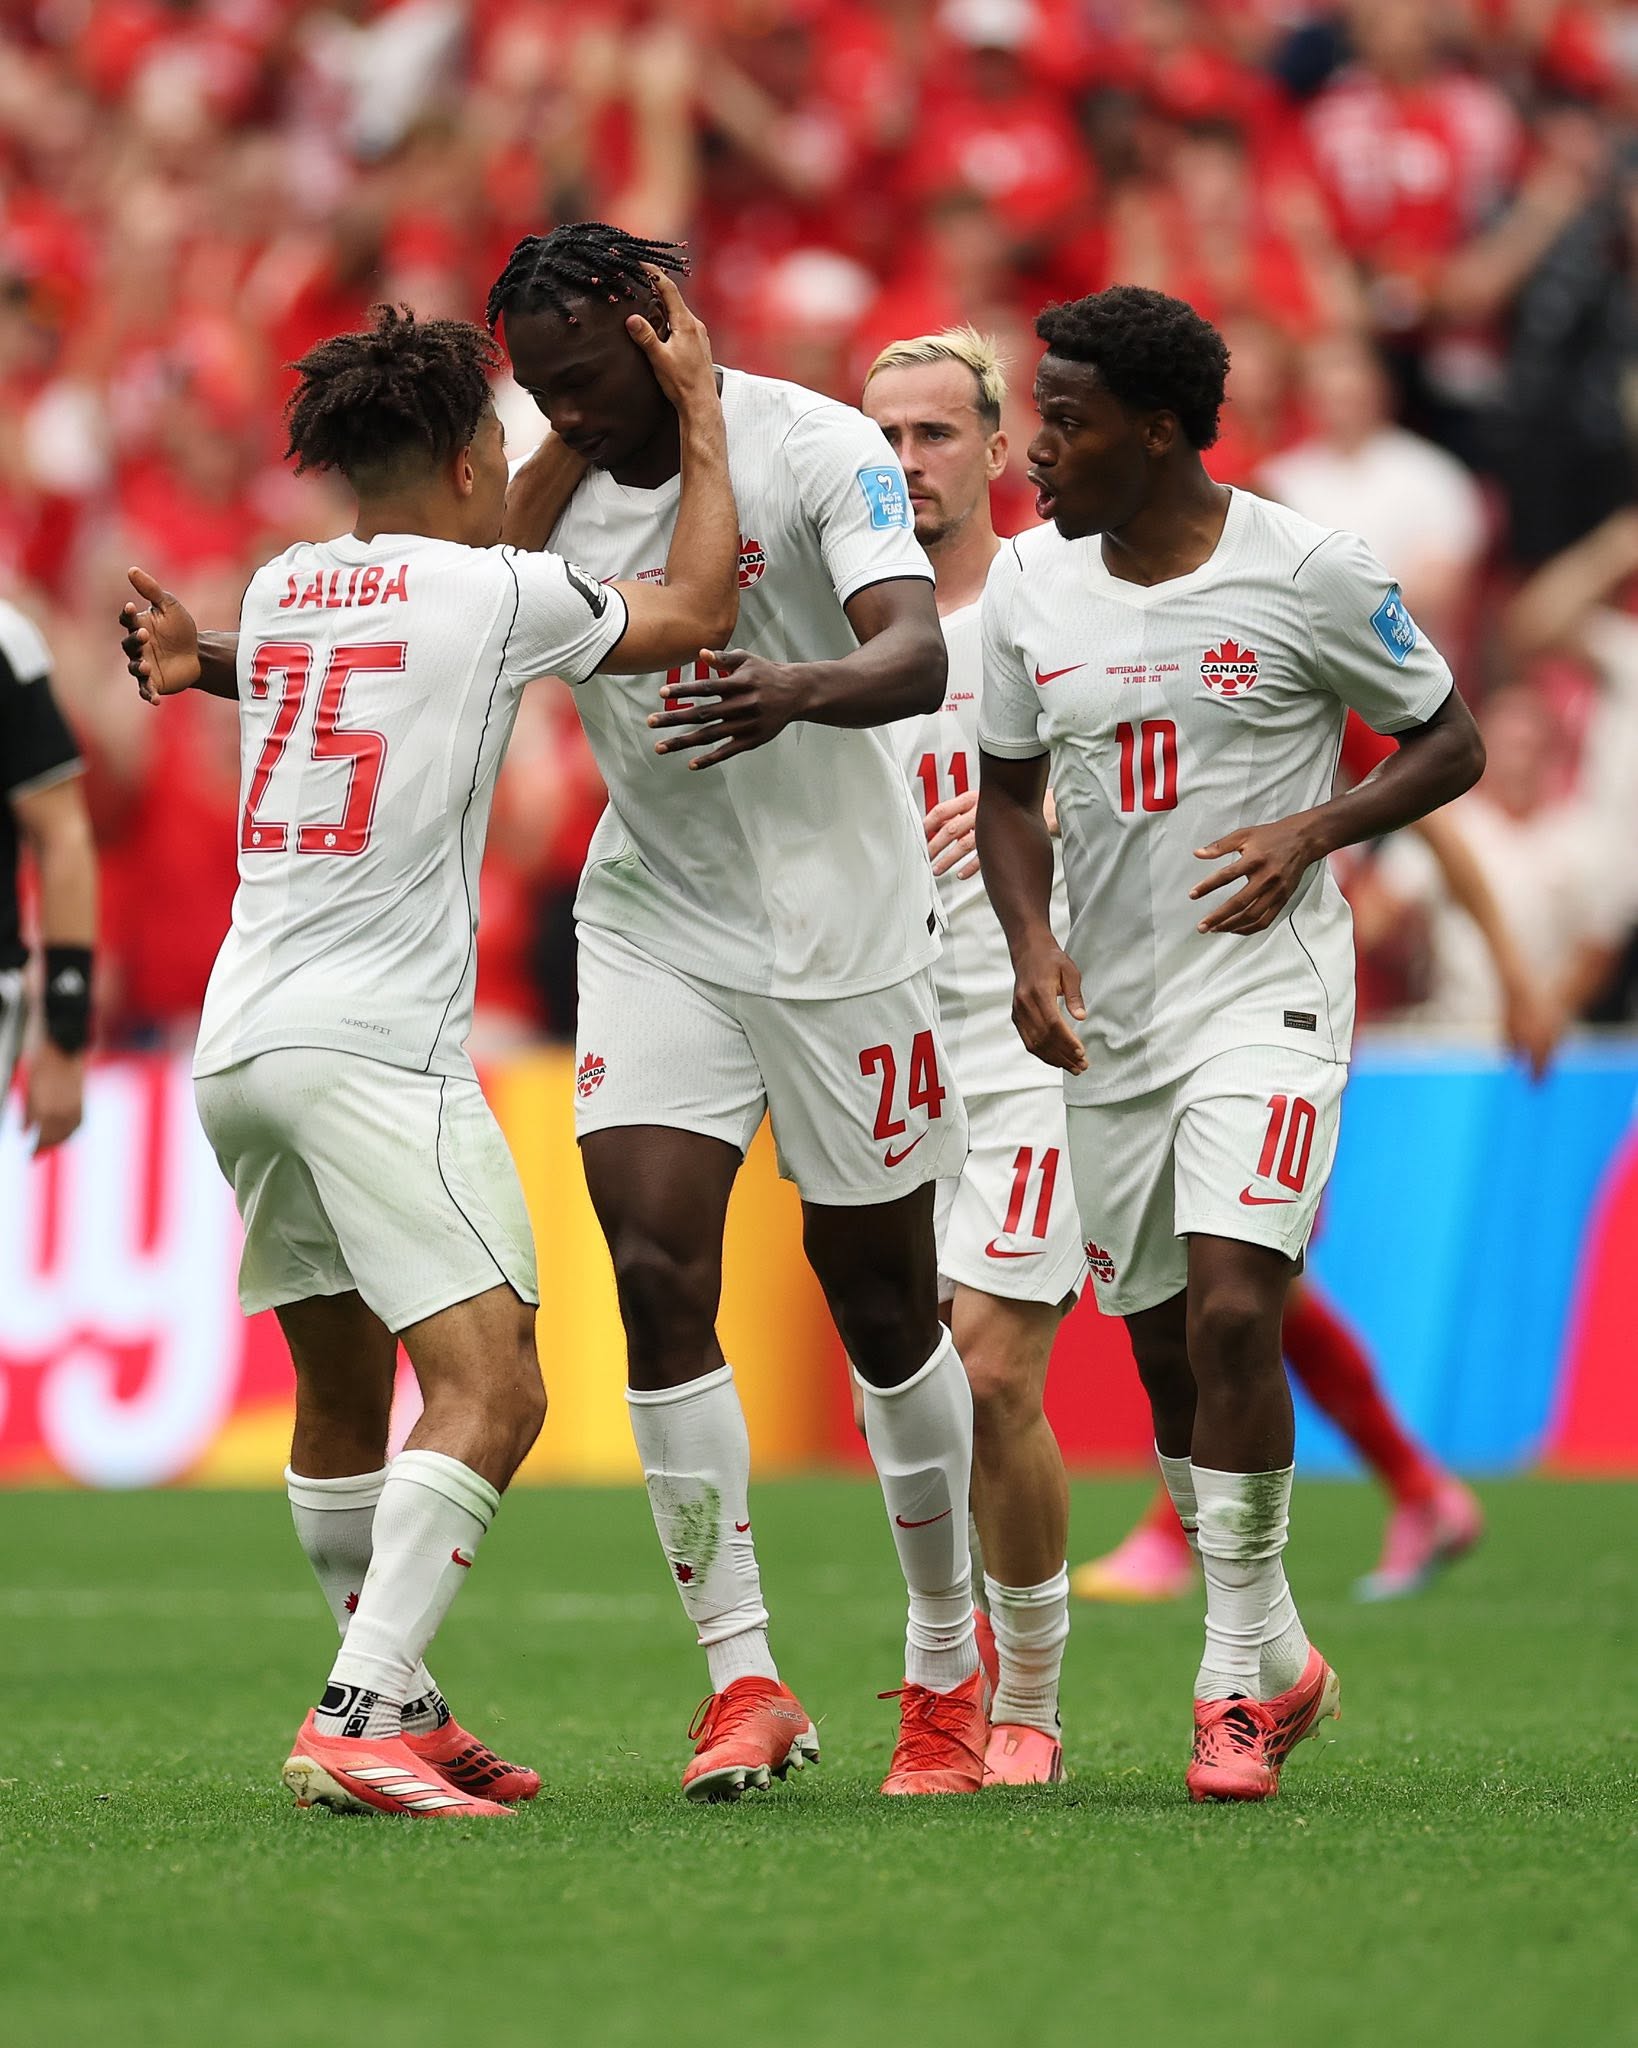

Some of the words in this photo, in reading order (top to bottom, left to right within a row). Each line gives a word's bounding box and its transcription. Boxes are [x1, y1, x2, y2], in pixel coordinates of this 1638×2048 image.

[279, 564, 409, 608] SALIBA
[636, 568, 665, 580] SWITZERL
[739, 553, 765, 565] ADA
[1155, 663, 1180, 672] CANADA
[1200, 664, 1258, 673] CANADA
[241, 641, 408, 855] 25
[1115, 719, 1178, 812] 10
[859, 1030, 946, 1141] 24
[1256, 1094, 1317, 1194] 10
[1004, 1147, 1060, 1239] 11
